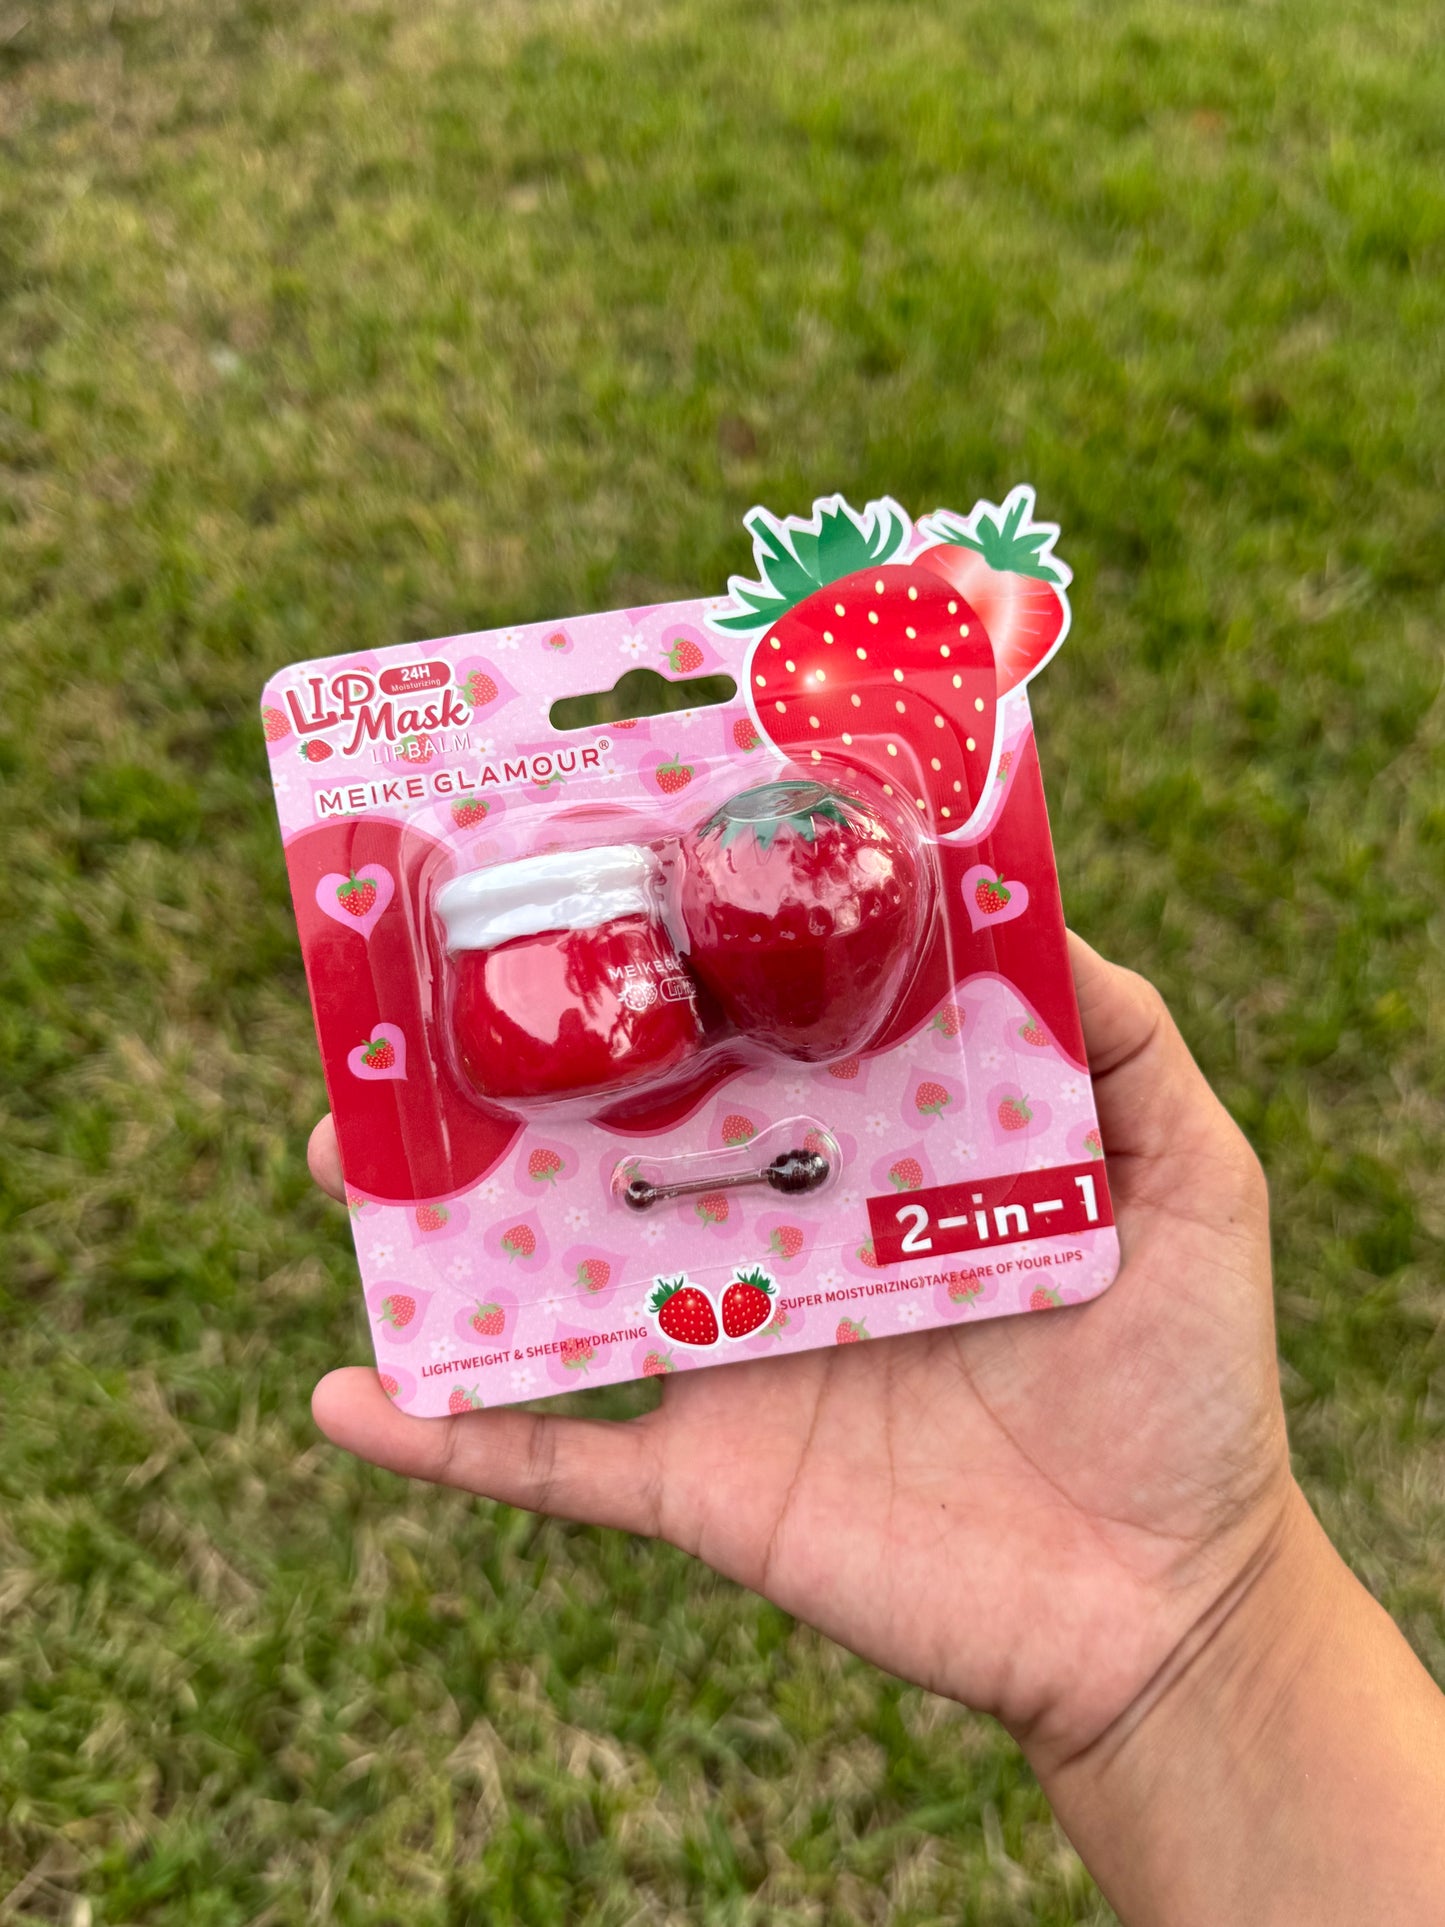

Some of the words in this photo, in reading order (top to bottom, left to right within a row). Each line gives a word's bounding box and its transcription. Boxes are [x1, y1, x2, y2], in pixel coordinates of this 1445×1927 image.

[286, 673, 375, 734] LIP
[391, 678, 441, 692] Moisturizing
[400, 664, 431, 682] 24H
[343, 689, 470, 755] Mask
[895, 1174, 1098, 1253] 2-in-1
[779, 1294, 823, 1311] SUPER
[960, 1264, 994, 1281] CARE
[996, 1260, 1013, 1274] OF
[1015, 1254, 1053, 1271] YOUR
[1054, 1249, 1083, 1264] LIPS
[421, 1350, 511, 1378] LIGHTWEIGHT
[513, 1349, 523, 1360] &
[575, 1326, 648, 1350] HYDRATING
